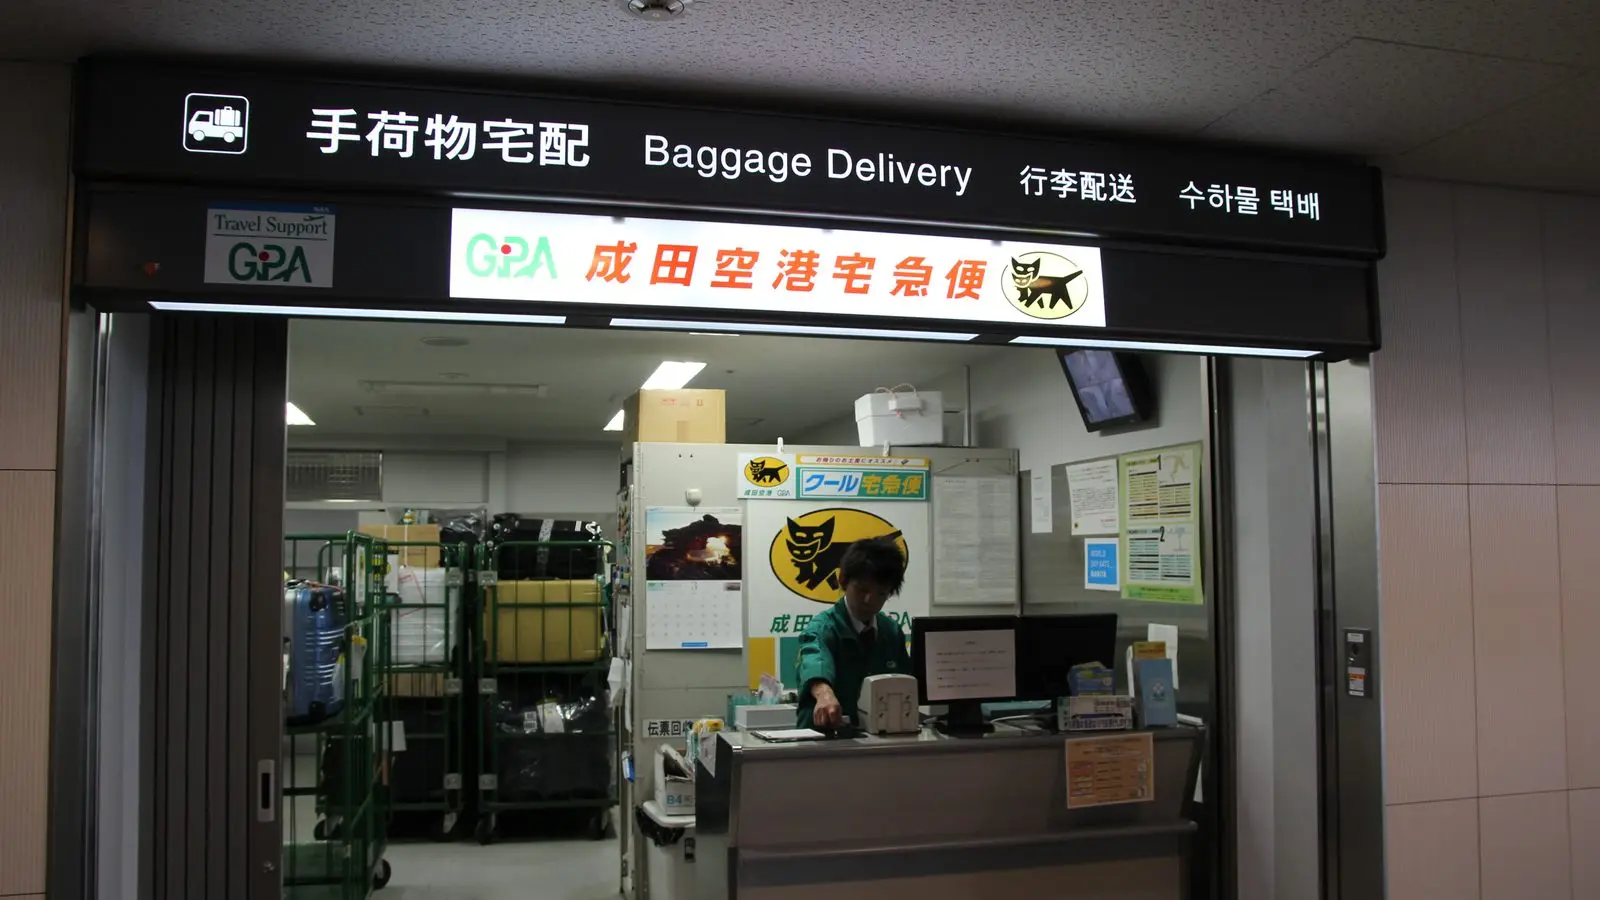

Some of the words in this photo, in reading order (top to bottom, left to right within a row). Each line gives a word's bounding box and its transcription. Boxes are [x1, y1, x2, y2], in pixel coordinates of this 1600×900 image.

[306, 108, 591, 168] 手荷物宅配
[645, 134, 812, 183] Baggage
[827, 148, 973, 197] Delivery
[1019, 164, 1137, 205] 行李配送
[1178, 180, 1261, 215] 수하물
[1270, 189, 1321, 221] 택배
[214, 213, 261, 232] Travel
[266, 216, 328, 236] Support
[228, 242, 313, 284] GPA
[466, 233, 557, 280] GPA
[585, 240, 988, 301] 成田空港宅急便
[804, 472, 924, 496] クール宅急便
